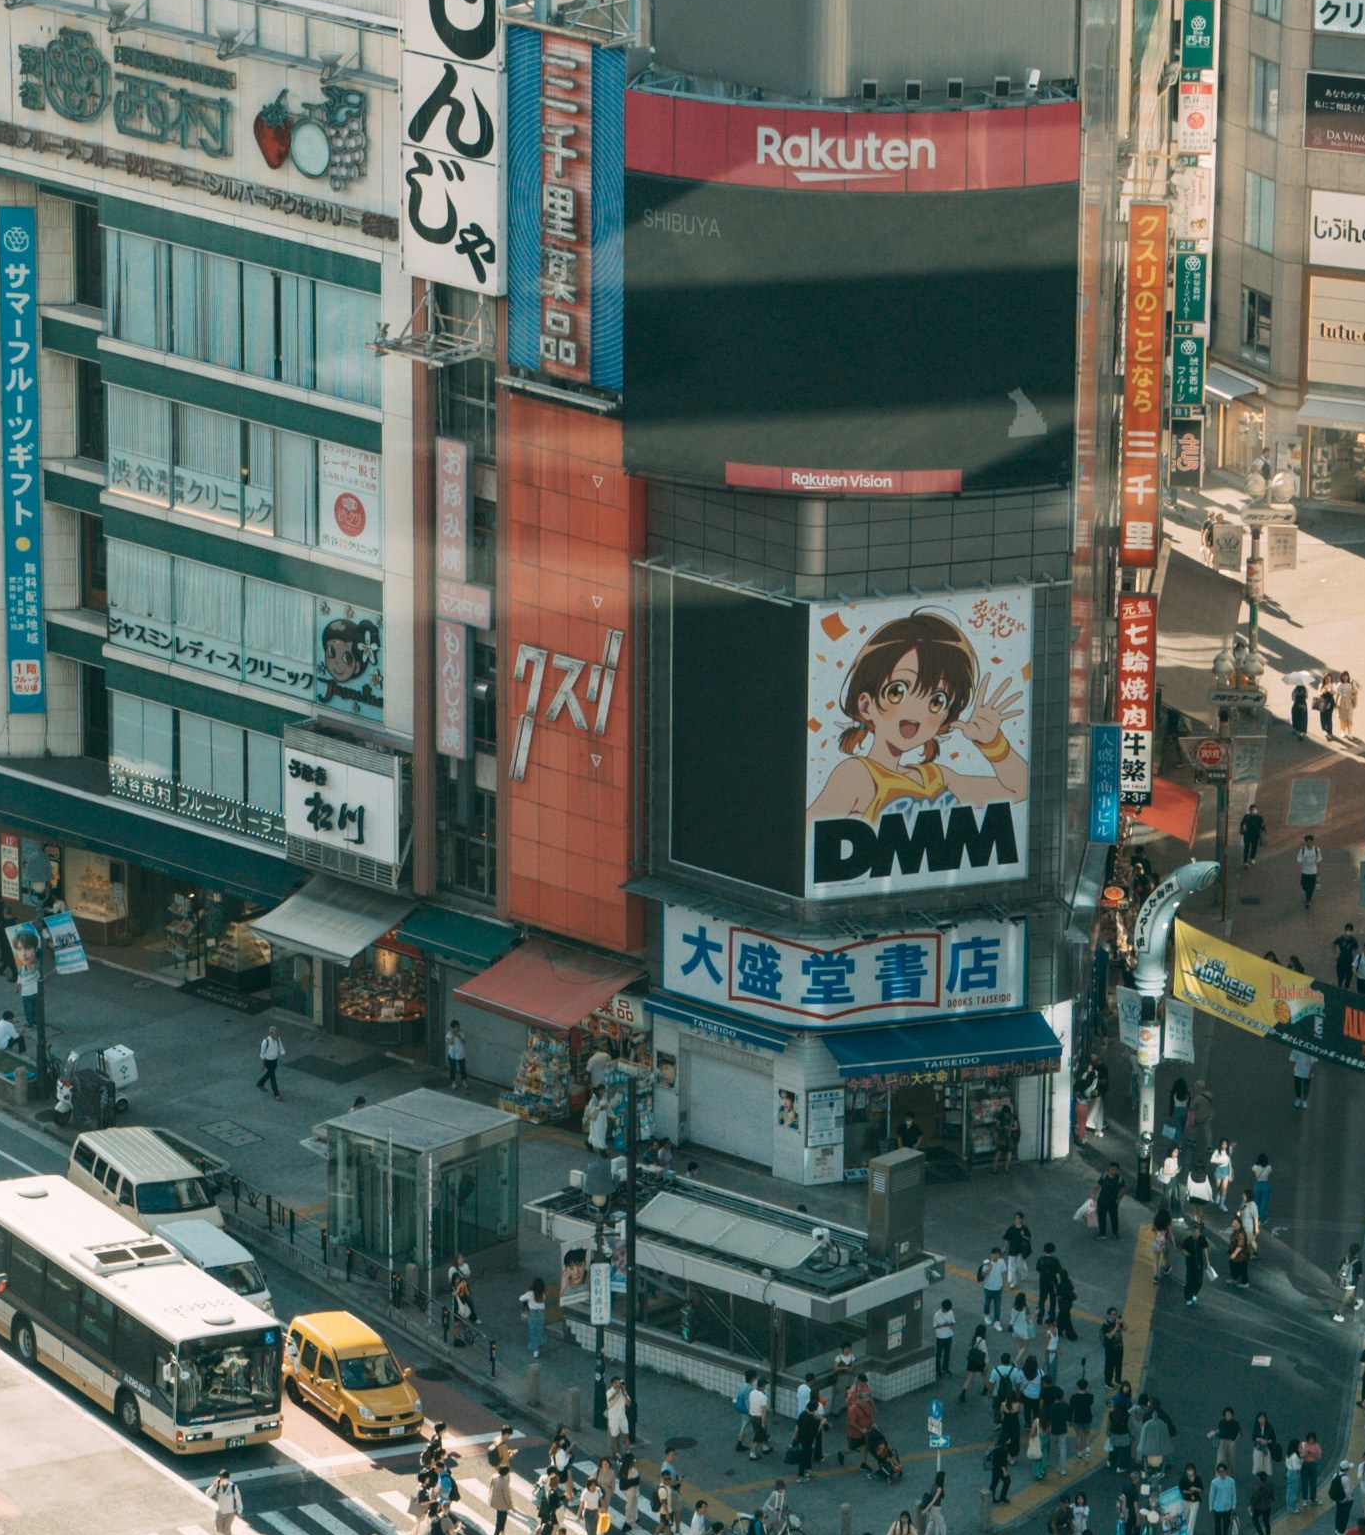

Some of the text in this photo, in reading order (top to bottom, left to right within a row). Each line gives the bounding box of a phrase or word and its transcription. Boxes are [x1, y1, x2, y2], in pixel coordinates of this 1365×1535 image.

[756, 126, 936, 172] Rakuten
[539, 53, 580, 367] 三千里薬品
[642, 208, 721, 239] SHIBUYA
[1132, 213, 1161, 416] クスリのことなら
[4, 264, 33, 526] サマーフルーツギフト
[791, 472, 892, 489] Rakuten Vision
[1125, 429, 1157, 550] 三千里
[509, 629, 624, 783] クスリ
[1120, 623, 1149, 728] 七輪焼肉
[813, 802, 1019, 884] DMM
[680, 926, 1000, 1004] 大盛堂書店
[948, 993, 1012, 1009] BOOKS TAISEIDO
[692, 1018, 737, 1038] TAISEIDO
[924, 1057, 980, 1069] TAISEIDO
